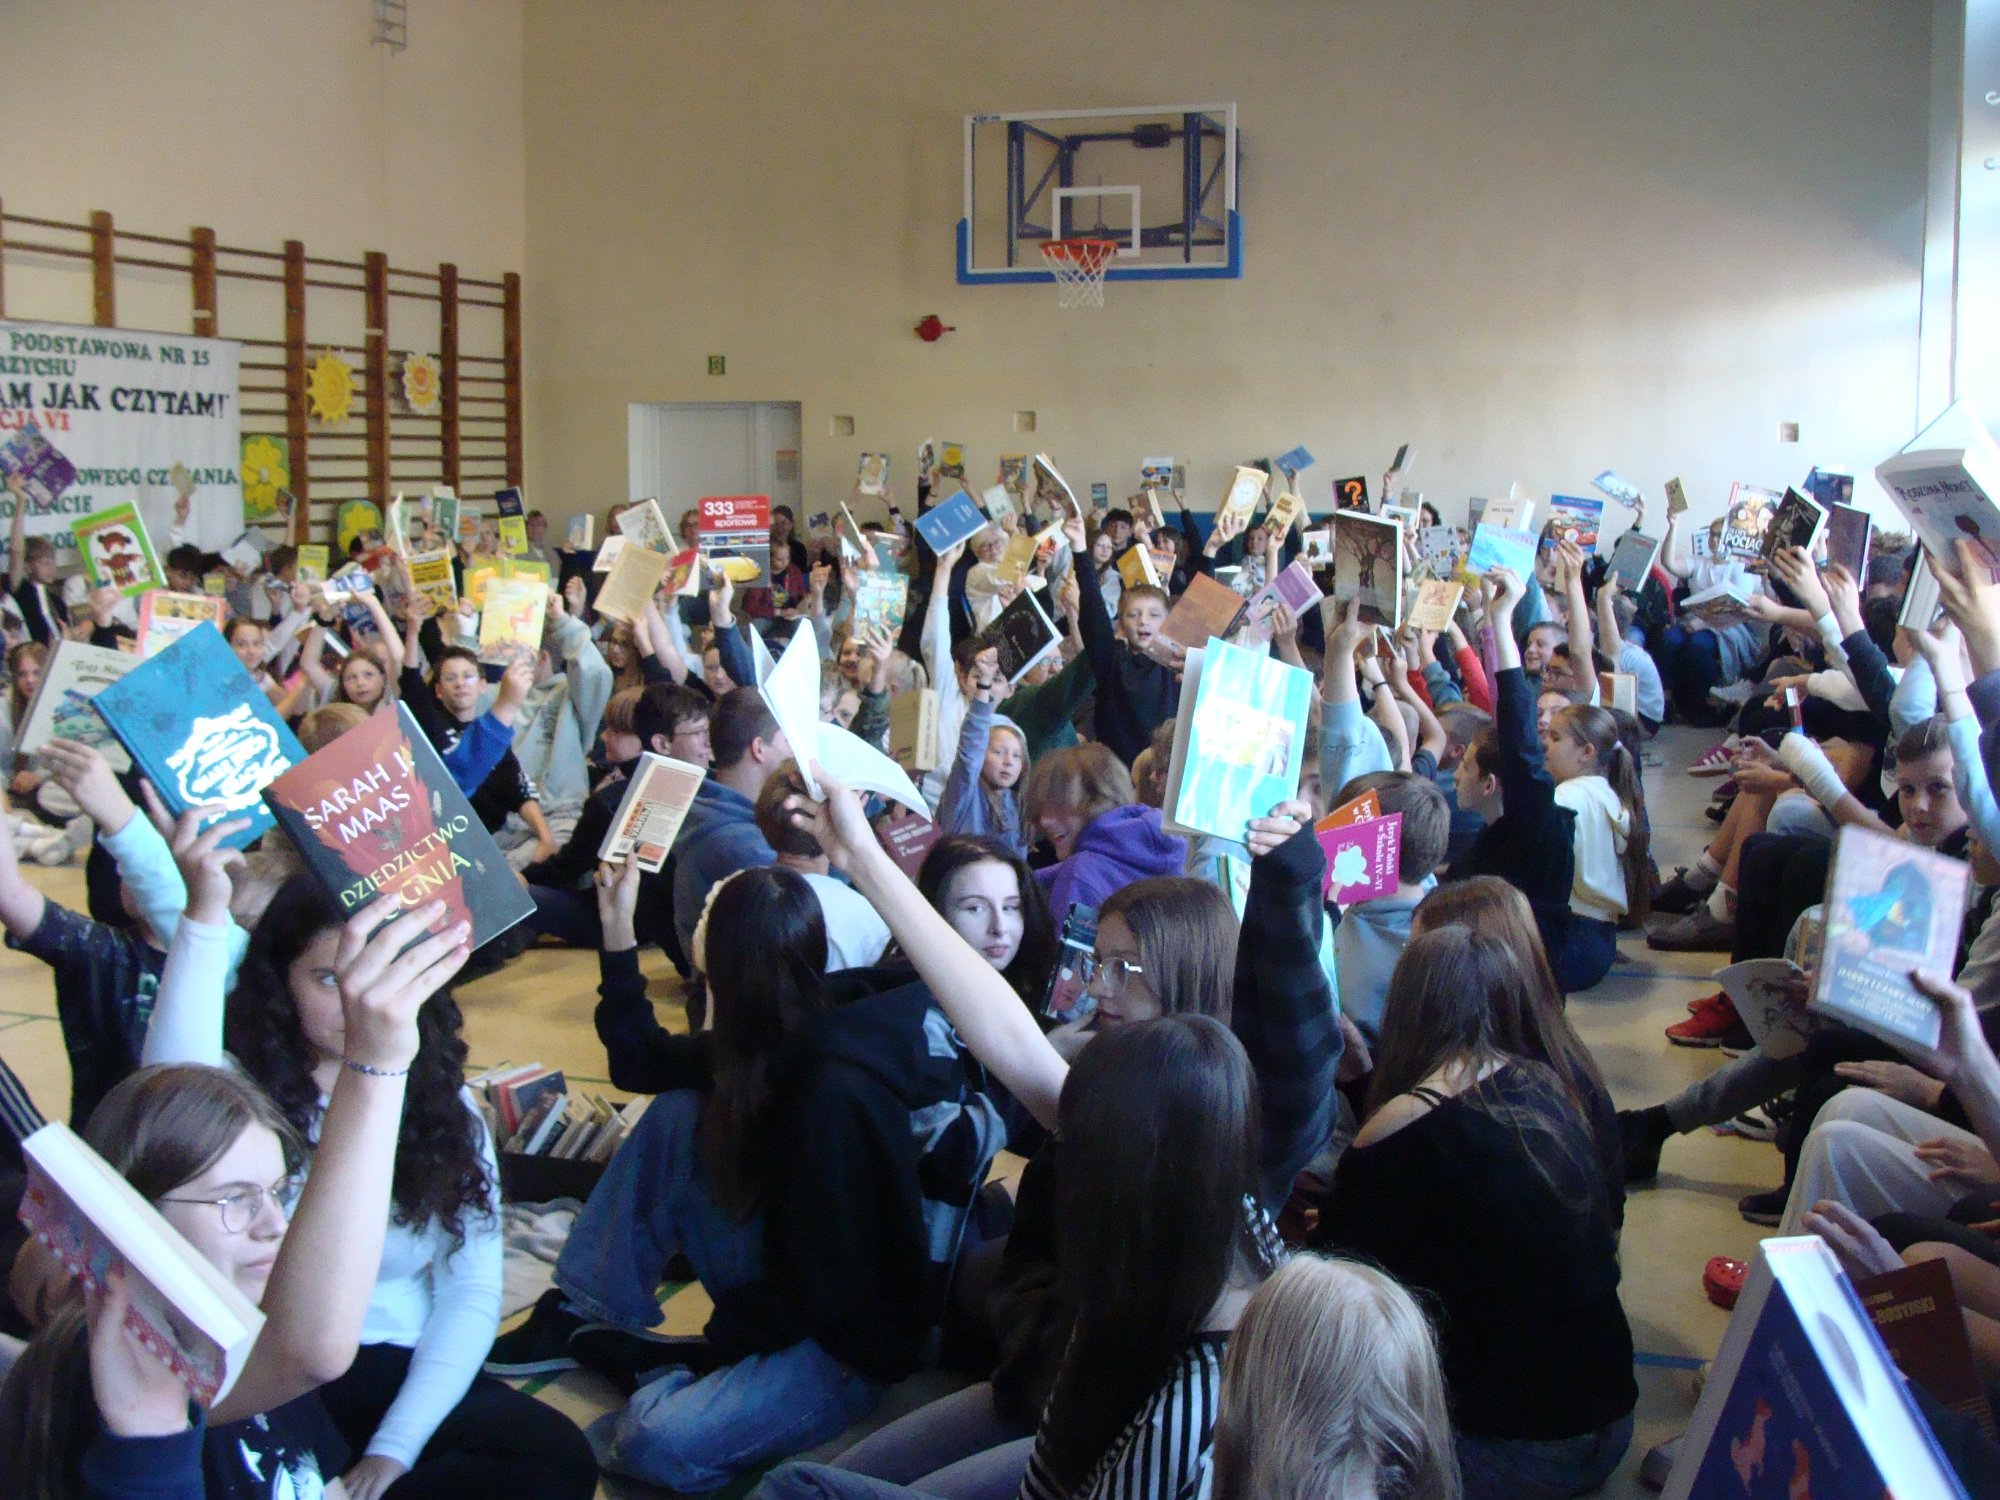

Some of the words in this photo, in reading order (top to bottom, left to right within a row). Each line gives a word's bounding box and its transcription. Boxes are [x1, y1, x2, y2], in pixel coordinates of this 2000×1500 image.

[9, 331, 151, 361] PODSTAWOWA
[159, 345, 186, 365] NR
[192, 350, 210, 366] 15
[42, 382, 101, 411] JAK
[44, 410, 70, 432] VI
[77, 468, 141, 486] OWEGO
[146, 468, 238, 486] CZANIA
[704, 501, 734, 516] 333
[714, 519, 758, 529] sportowe
[304, 763, 391, 831] SARAH
[338, 785, 411, 845] MAAS
[1376, 833, 1386, 863] Szkole
[1386, 821, 1397, 846] Język
[340, 815, 469, 908] DZIEDZICTWO
[1386, 847, 1396, 875] Polski
[384, 851, 472, 921] GNIA
